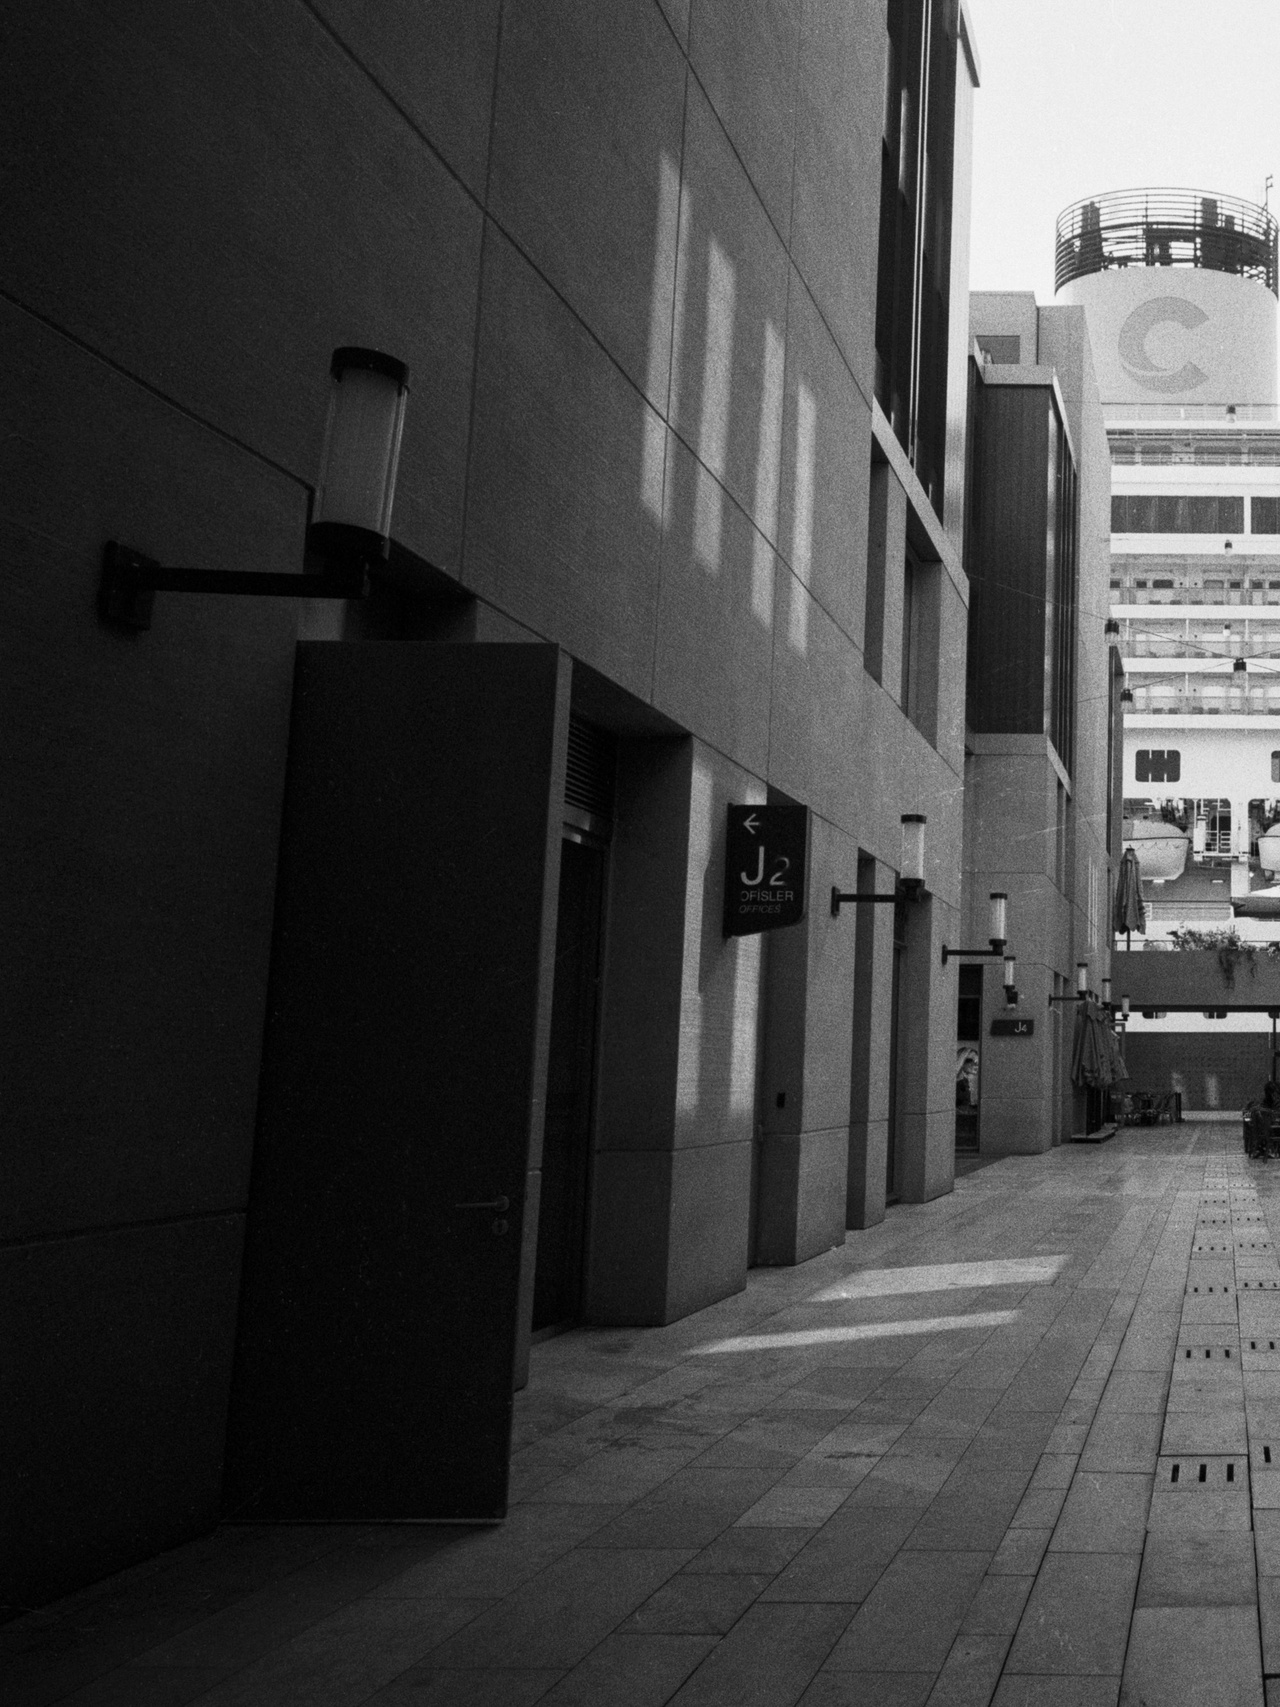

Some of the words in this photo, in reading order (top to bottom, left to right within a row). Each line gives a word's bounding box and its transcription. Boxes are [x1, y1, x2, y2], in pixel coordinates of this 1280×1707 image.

[1118, 296, 1210, 394] C
[741, 845, 790, 886] J2
[739, 903, 782, 914] OFFICES
